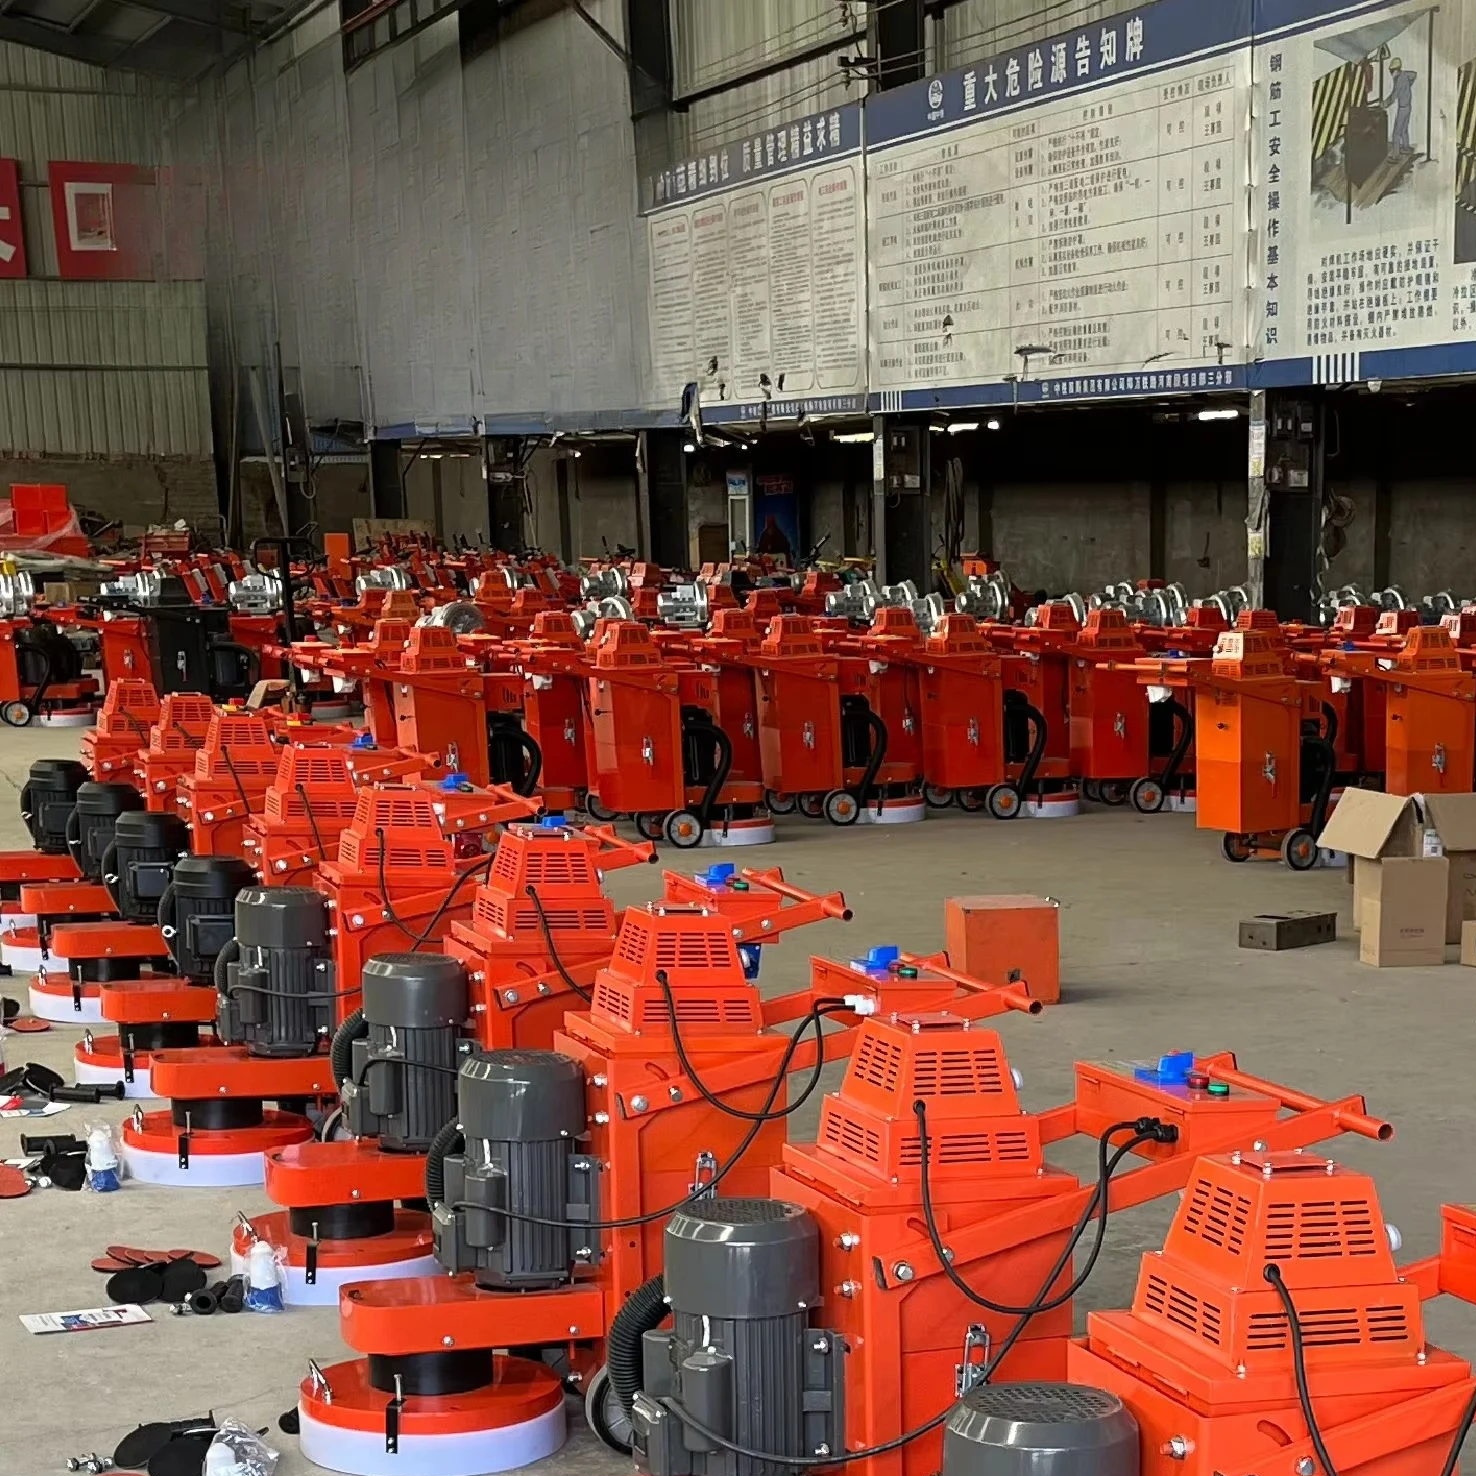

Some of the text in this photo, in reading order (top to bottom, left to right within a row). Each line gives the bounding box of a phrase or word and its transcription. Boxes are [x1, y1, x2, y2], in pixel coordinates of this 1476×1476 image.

[962, 16, 1144, 111] 重大危险源告知牌
[742, 111, 841, 173] 质量管理精益求精
[1265, 53, 1283, 346] 钢筋工安全操作基本知识
